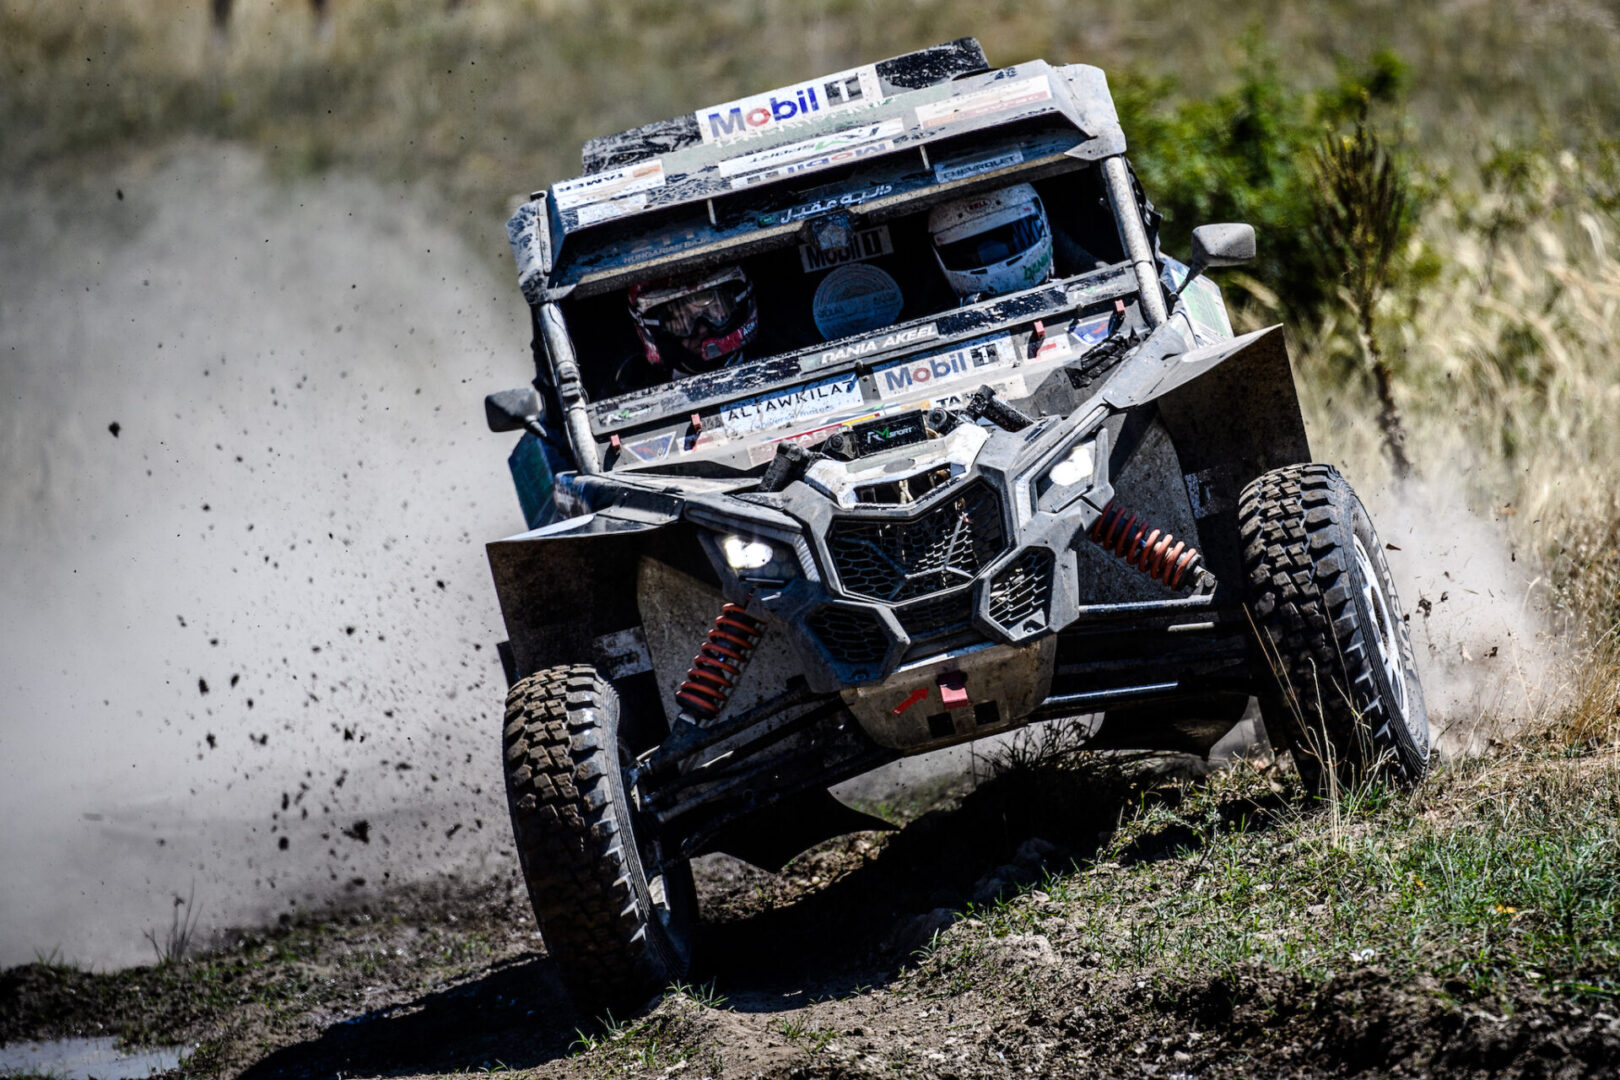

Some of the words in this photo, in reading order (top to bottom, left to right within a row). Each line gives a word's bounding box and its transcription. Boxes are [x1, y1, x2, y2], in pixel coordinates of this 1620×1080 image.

[708, 87, 819, 138] Mobil
[943, 156, 1016, 180] CHEVROLET
[821, 340, 877, 365] DANIA
[883, 325, 937, 348] AKEEL
[884, 351, 967, 391] Mobil
[728, 380, 854, 421] ALTAWKILAT
